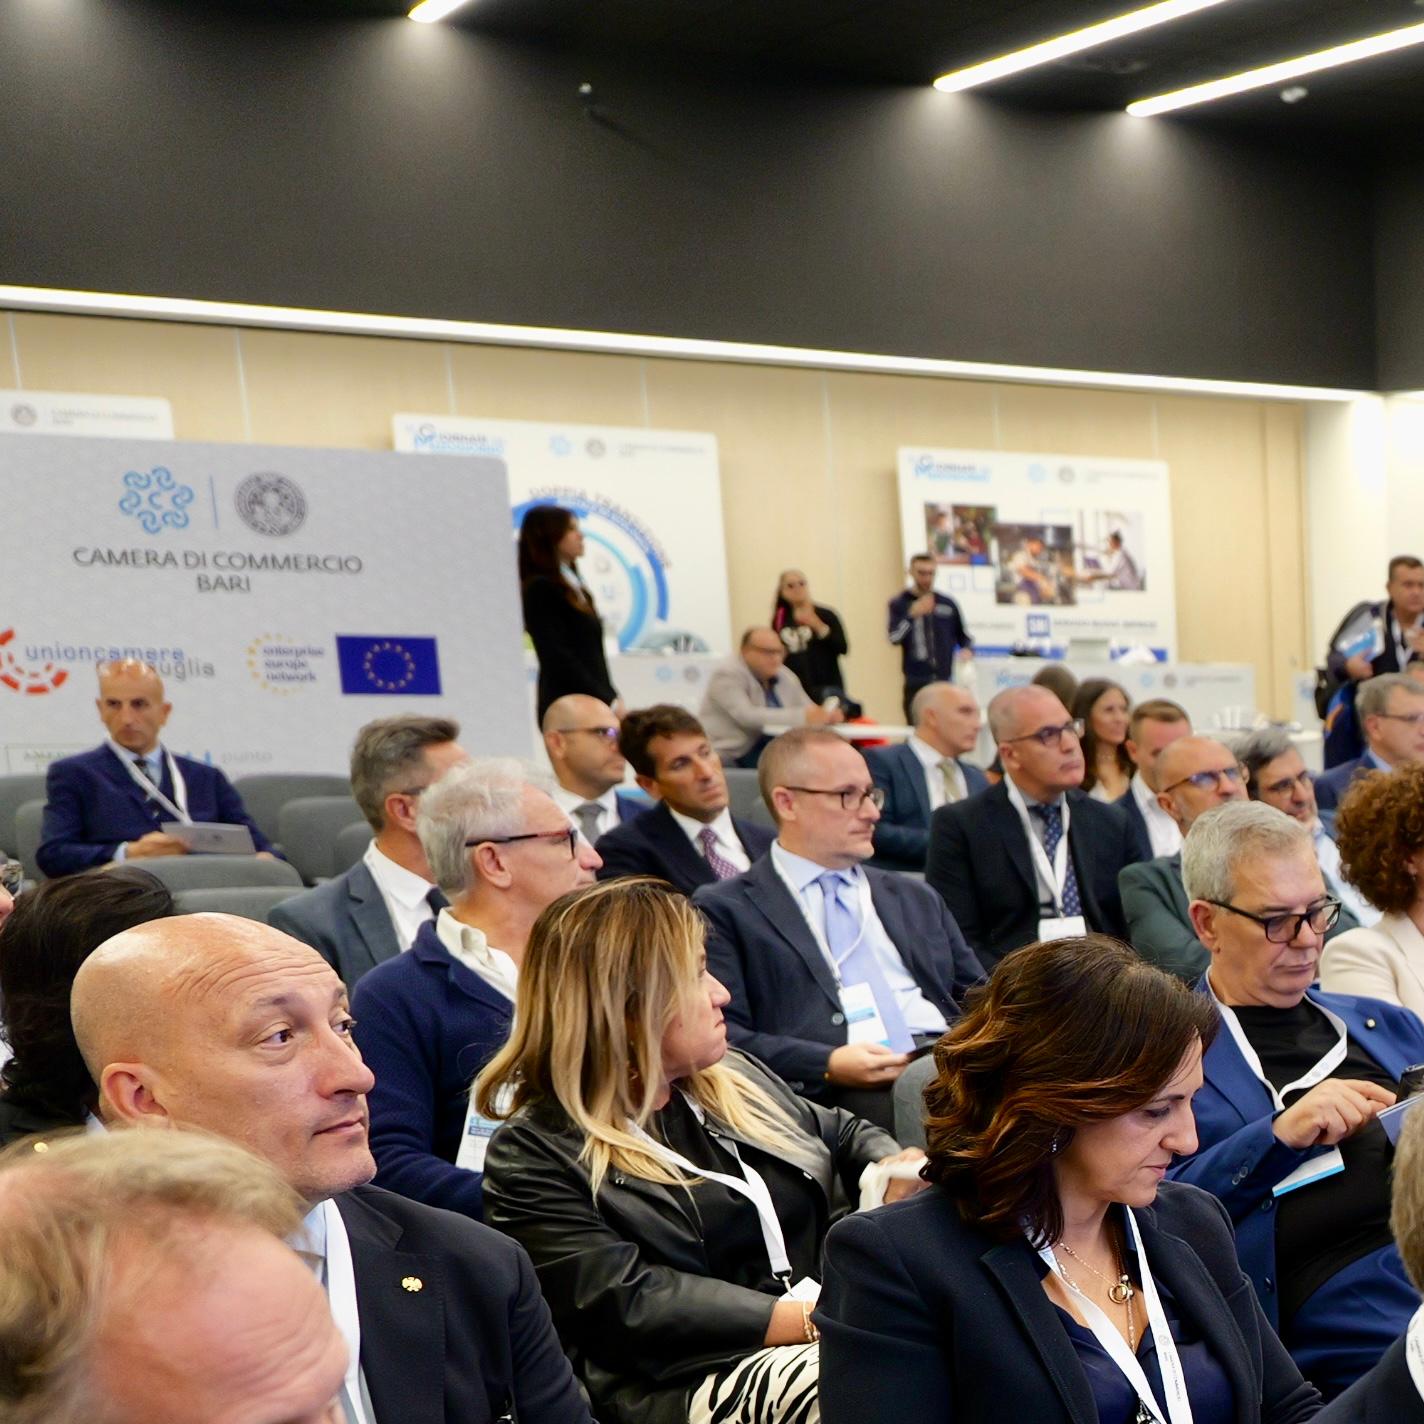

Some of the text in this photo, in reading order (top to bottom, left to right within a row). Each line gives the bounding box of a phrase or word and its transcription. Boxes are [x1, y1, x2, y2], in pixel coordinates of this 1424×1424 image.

[73, 547, 363, 574] CAMERA DI COMMERCIO
[197, 574, 251, 593] BARI
[146, 657, 216, 682] uglia
